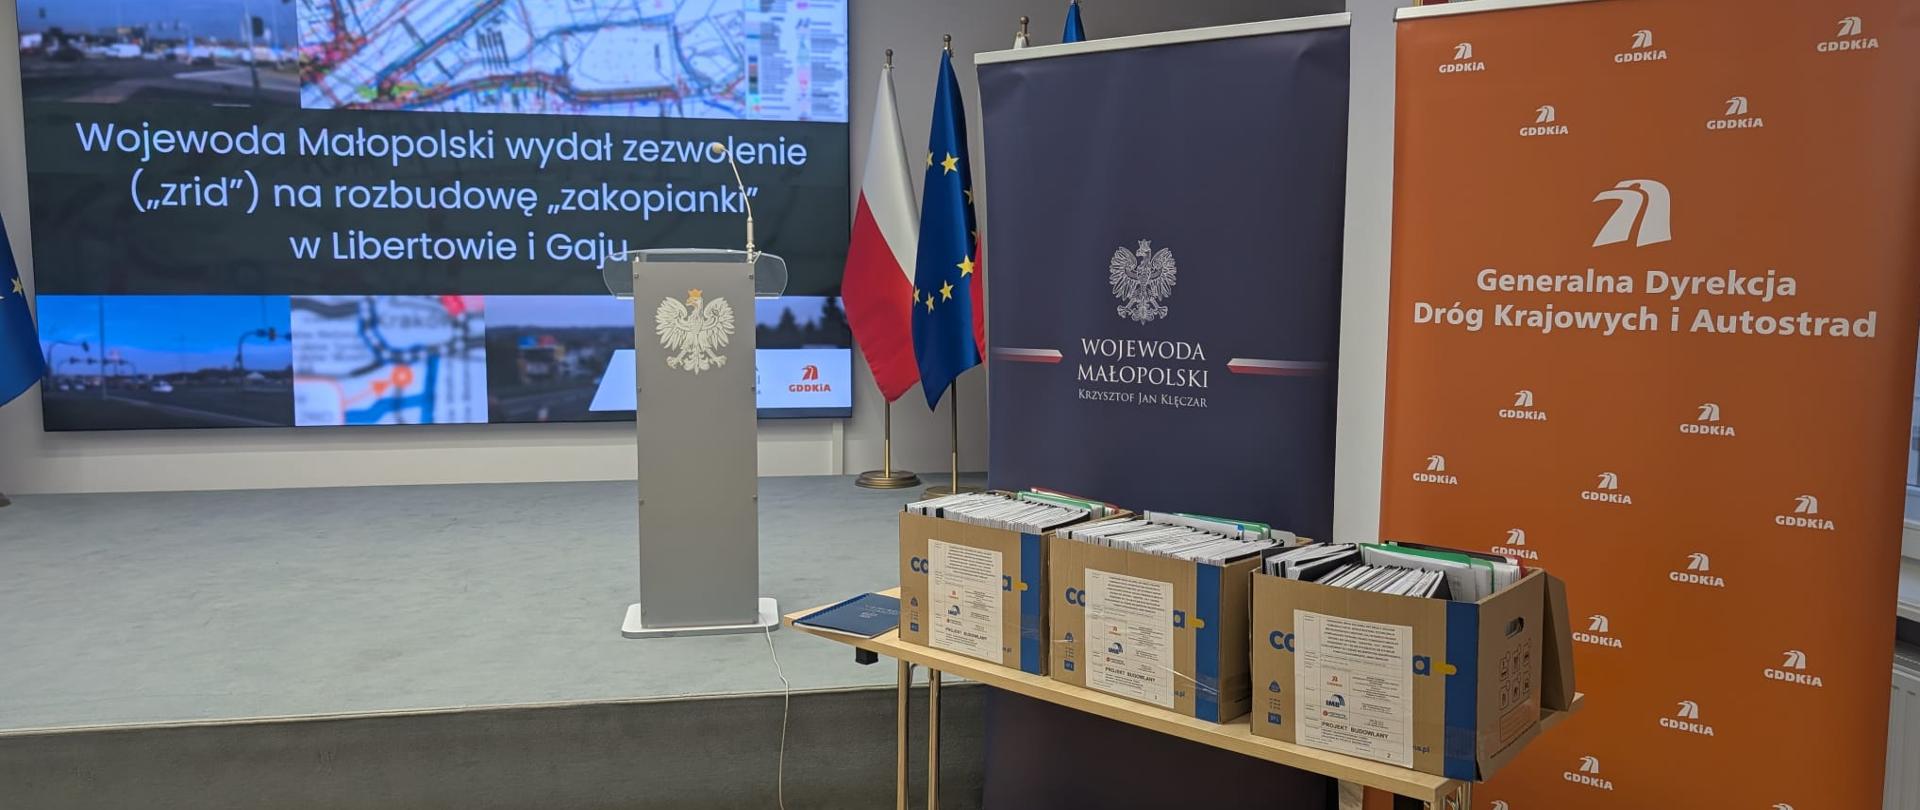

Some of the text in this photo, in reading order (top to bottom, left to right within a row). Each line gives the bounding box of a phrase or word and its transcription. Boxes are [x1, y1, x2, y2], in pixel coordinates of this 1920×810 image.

[1816, 38, 1879, 52] GDDKiA
[1614, 50, 1667, 63] GDDKiA
[1438, 62, 1485, 73] GDDKiA
[1519, 125, 1569, 137] GDDKiA
[1706, 118, 1764, 130] GDDKiA
[75, 122, 807, 168] Wojewoda Małopolski wydał zezwolenie
[274, 184, 321, 208] na
[335, 180, 538, 217] rozbudowę
[289, 230, 628, 270] w Libertowie i Gaju
[1477, 269, 1797, 302] Generalna Dyrekcja
[1414, 302, 1877, 338] Dróg Krajowych i Autostrad
[1081, 338, 1206, 361] WOJEWODA
[1077, 364, 1208, 388] MAŁOPOLSKI
[788, 384, 831, 392] GDDKiA
[1498, 409, 1547, 421] GDDKiA
[1679, 423, 1735, 437] GDDKiA
[1412, 473, 1458, 485] GDDKiA
[1581, 490, 1632, 505] GDDKiA
[1775, 514, 1834, 531] GDDKiA
[1491, 546, 1538, 560] GDDKiA
[1669, 571, 1725, 588] GDDKiA
[1572, 631, 1623, 649] GDDKiA
[1764, 668, 1823, 687] GDDKiA
[1321, 721, 1347, 731] PROJEKT
[1350, 727, 1388, 740] BUDOWLANY
[1659, 717, 1714, 737] GDDKiA
[1563, 771, 1613, 791] GDDKiA
